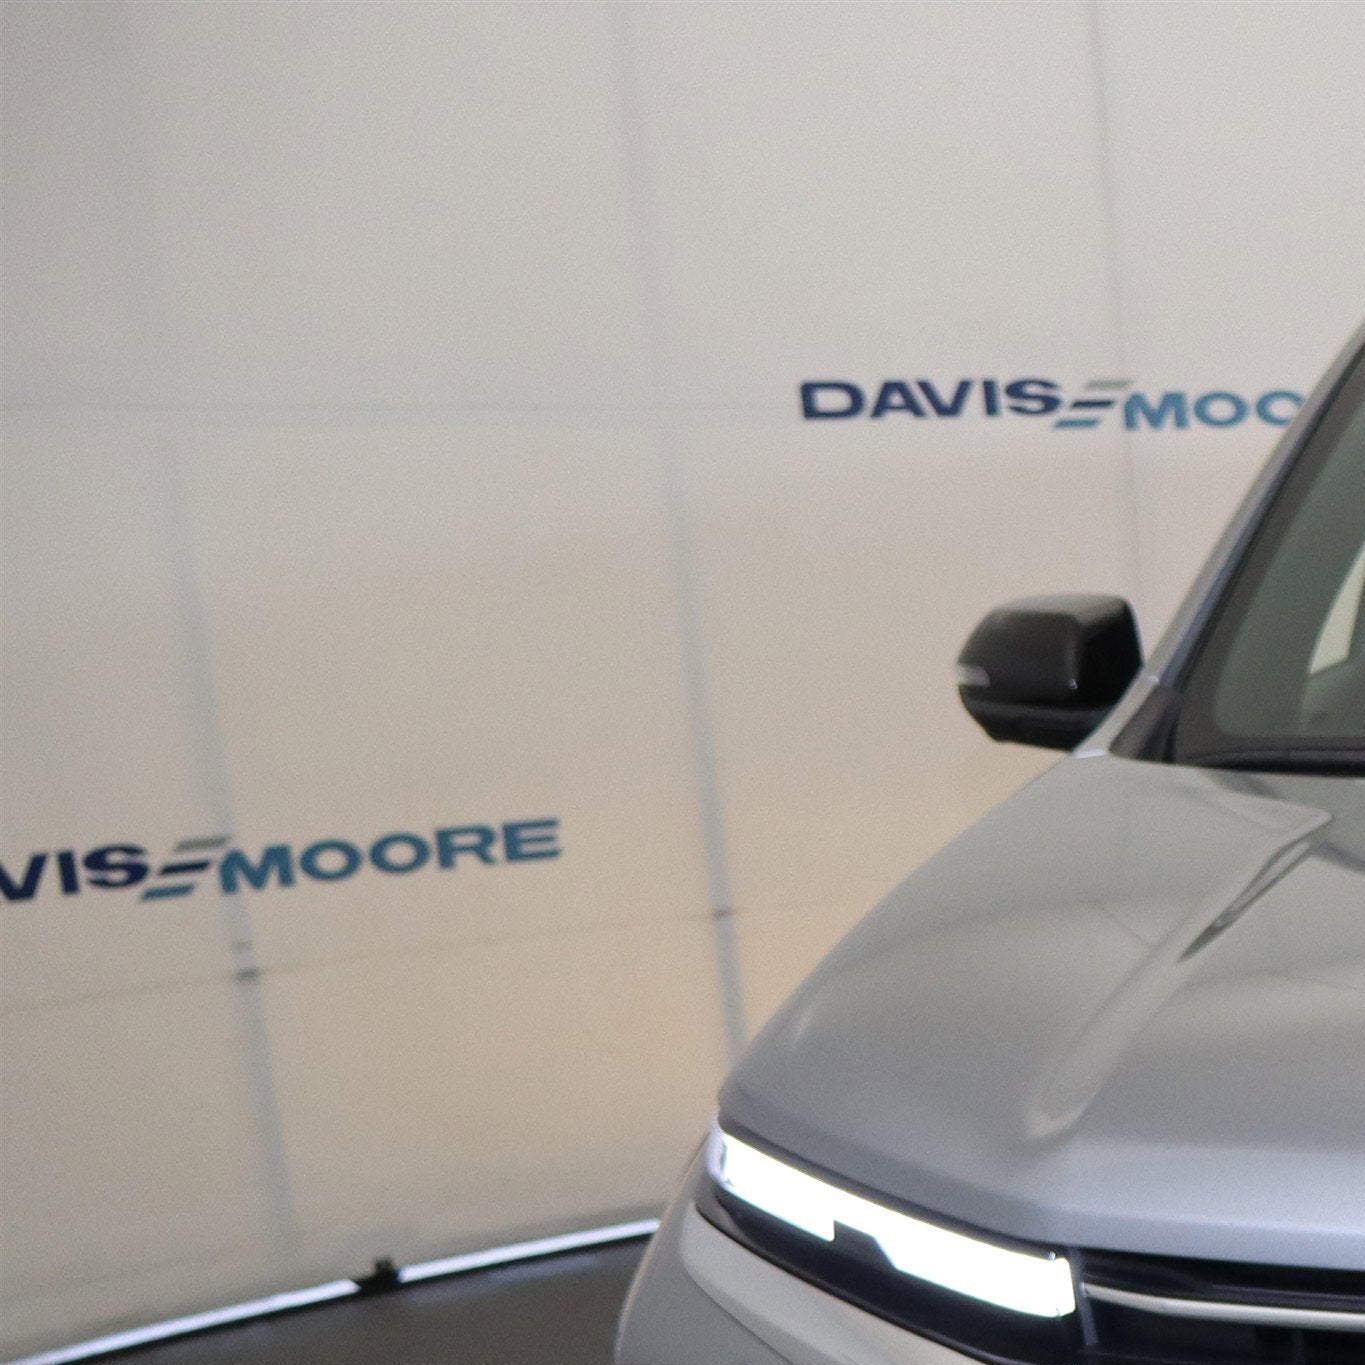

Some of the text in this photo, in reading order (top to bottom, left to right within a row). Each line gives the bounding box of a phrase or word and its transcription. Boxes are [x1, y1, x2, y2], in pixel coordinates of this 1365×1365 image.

[800, 379, 1302, 430] DAVIS MOO
[0, 817, 562, 900] VIS MOORE
